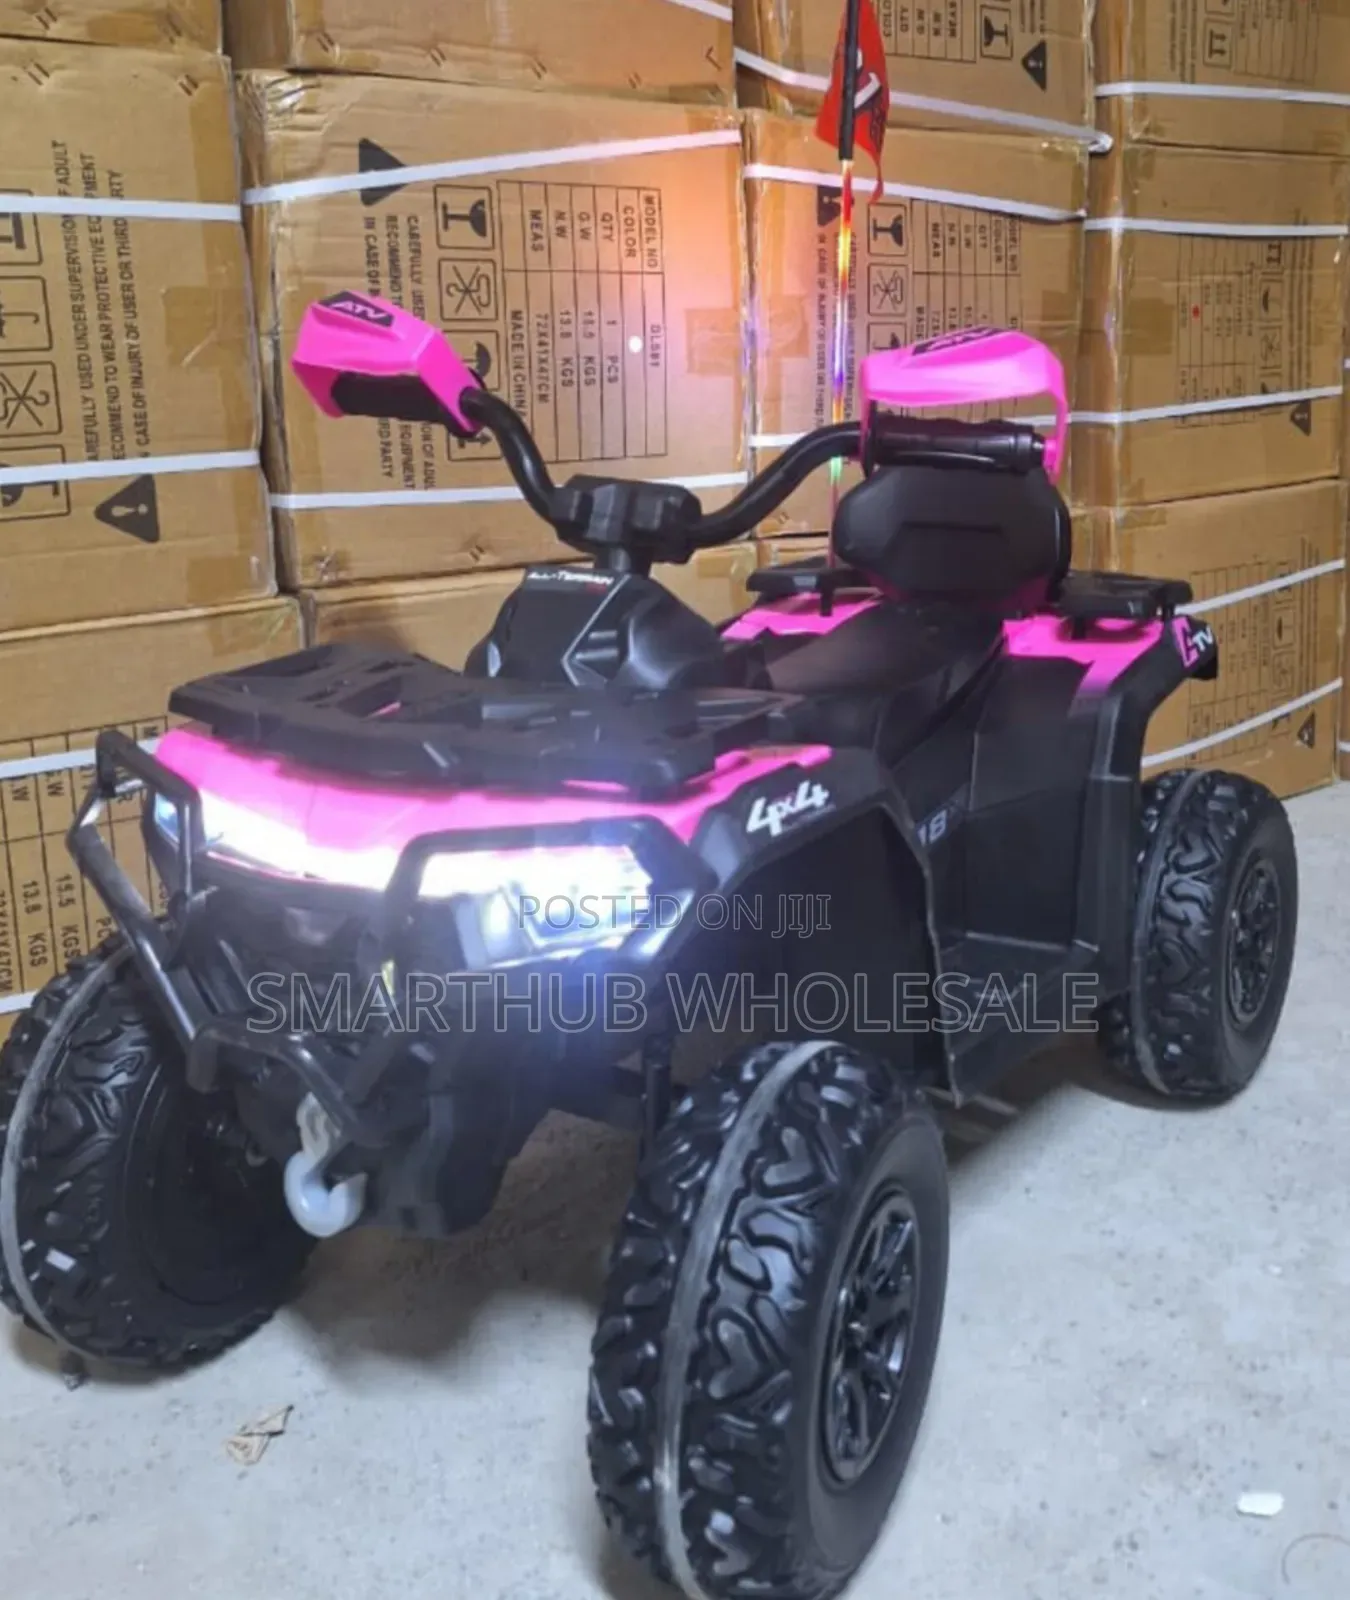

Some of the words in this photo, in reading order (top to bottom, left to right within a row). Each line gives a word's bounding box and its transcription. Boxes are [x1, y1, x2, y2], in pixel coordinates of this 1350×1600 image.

[52, 140, 71, 186] ADULT
[113, 217, 131, 257] THIRD
[528, 209, 545, 253] MEAS
[600, 211, 615, 242] QTY
[622, 205, 637, 259] COLOR
[643, 194, 658, 245] MODEL
[365, 233, 380, 268] CASE
[386, 215, 403, 291] RECOMMEND
[407, 215, 424, 284] CAREFULLY
[646, 248, 659, 269] NO
[89, 236, 112, 322] PROTECTIVE
[118, 258, 135, 281] OR
[119, 284, 137, 321] USER
[71, 303, 89, 351] UNDER
[97, 324, 117, 364] WEAR
[124, 321, 140, 341] OF
[511, 310, 525, 352] MADE
[77, 353, 94, 390] USED
[104, 366, 119, 385] TO
[126, 344, 145, 389] INJURY
[513, 354, 526, 370] IN
[560, 355, 575, 388] KGS
[583, 355, 597, 387] KGS
[607, 354, 620, 384] PCS
[131, 391, 147, 410] OF
[81, 395, 99, 461] AREFULLY
[106, 387, 125, 460] ECOMMEND
[133, 411, 151, 446] CASE
[380, 440, 395, 478] PARTY
[423, 460, 437, 490] ADUL
[745, 779, 831, 838] 4x4
[22, 880, 43, 915] 13.8
[28, 932, 48, 967] KGS
[61, 924, 81, 958] KGS
